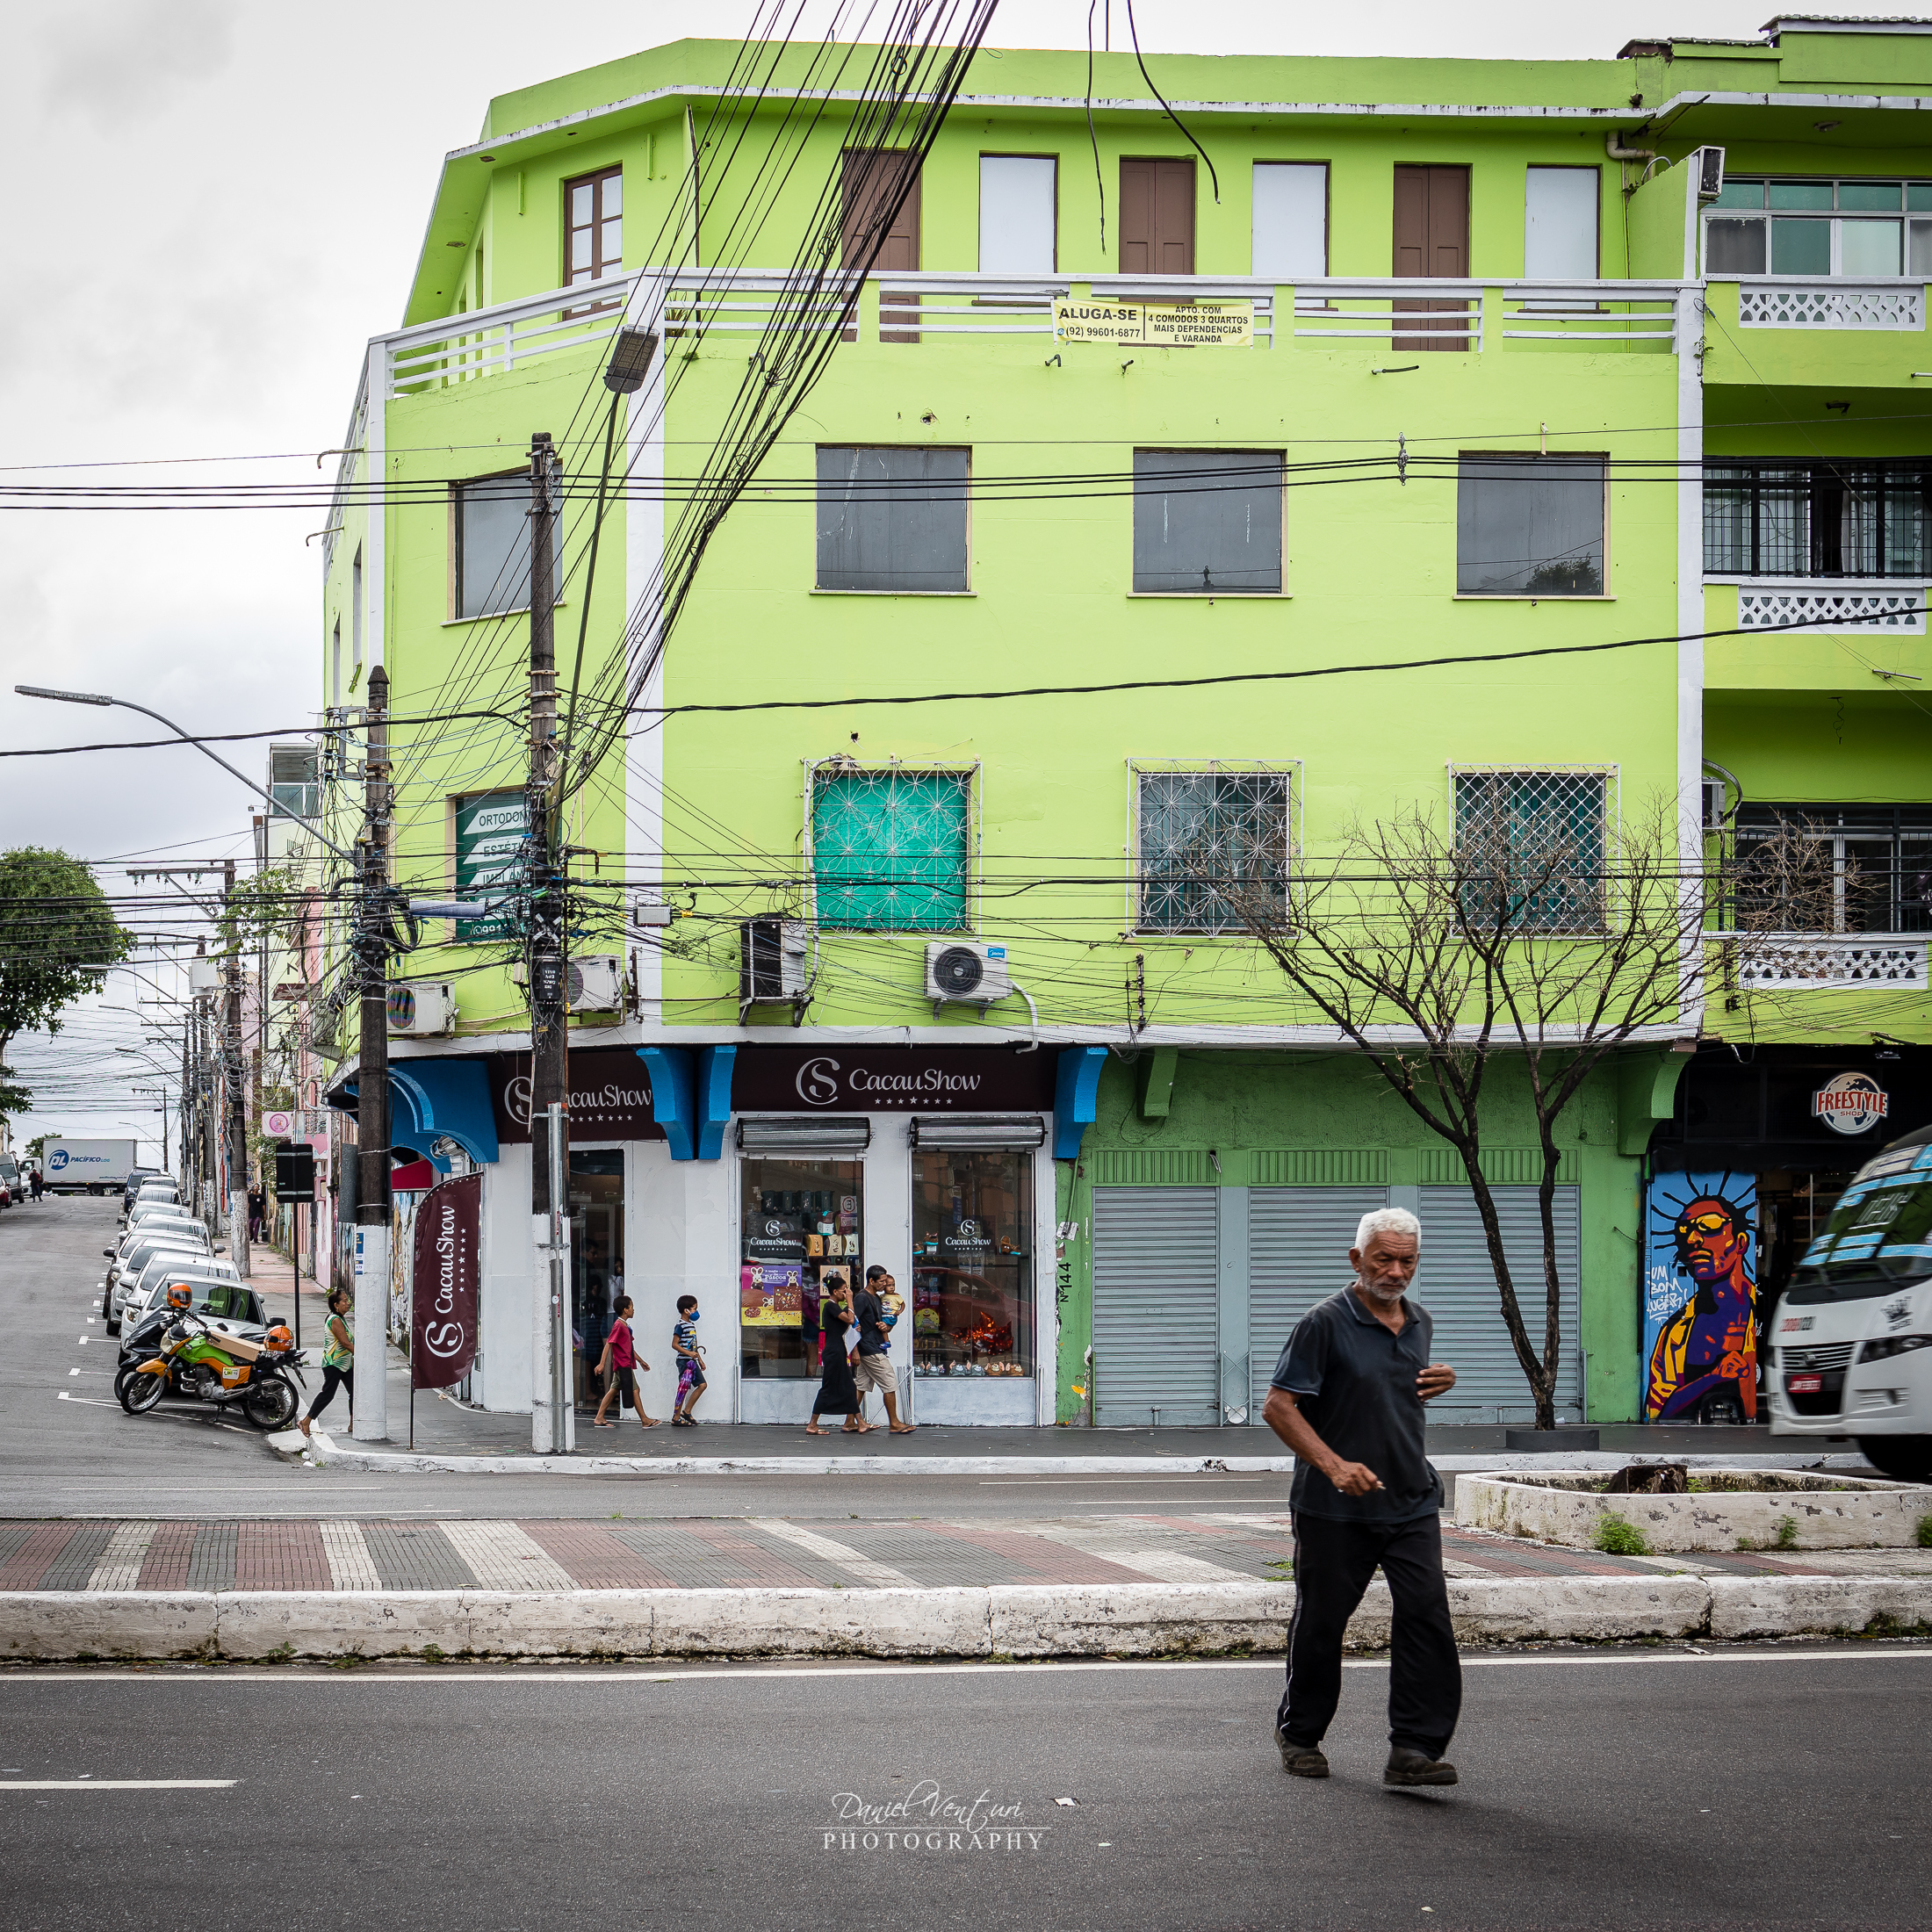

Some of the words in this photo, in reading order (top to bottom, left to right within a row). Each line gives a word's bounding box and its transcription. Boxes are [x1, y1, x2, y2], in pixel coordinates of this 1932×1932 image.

[1059, 307, 1137, 321] ALUGA-SE
[1208, 316, 1248, 325] QUARTOS
[1066, 327, 1084, 337] (92)
[1087, 328, 1140, 338] 99601-6877
[1178, 325, 1243, 334] DEPENDENCIAS
[479, 811, 524, 826] ORTODON
[848, 1069, 980, 1092] CacauShow
[567, 1085, 652, 1108] cauShow
[1818, 1092, 1886, 1114] FREESTYLE
[750, 1237, 797, 1246] CacauShow
[946, 1236, 991, 1246] CacauShow
[435, 1205, 455, 1314] CacauShow
[1647, 1277, 1683, 1294] BOM
